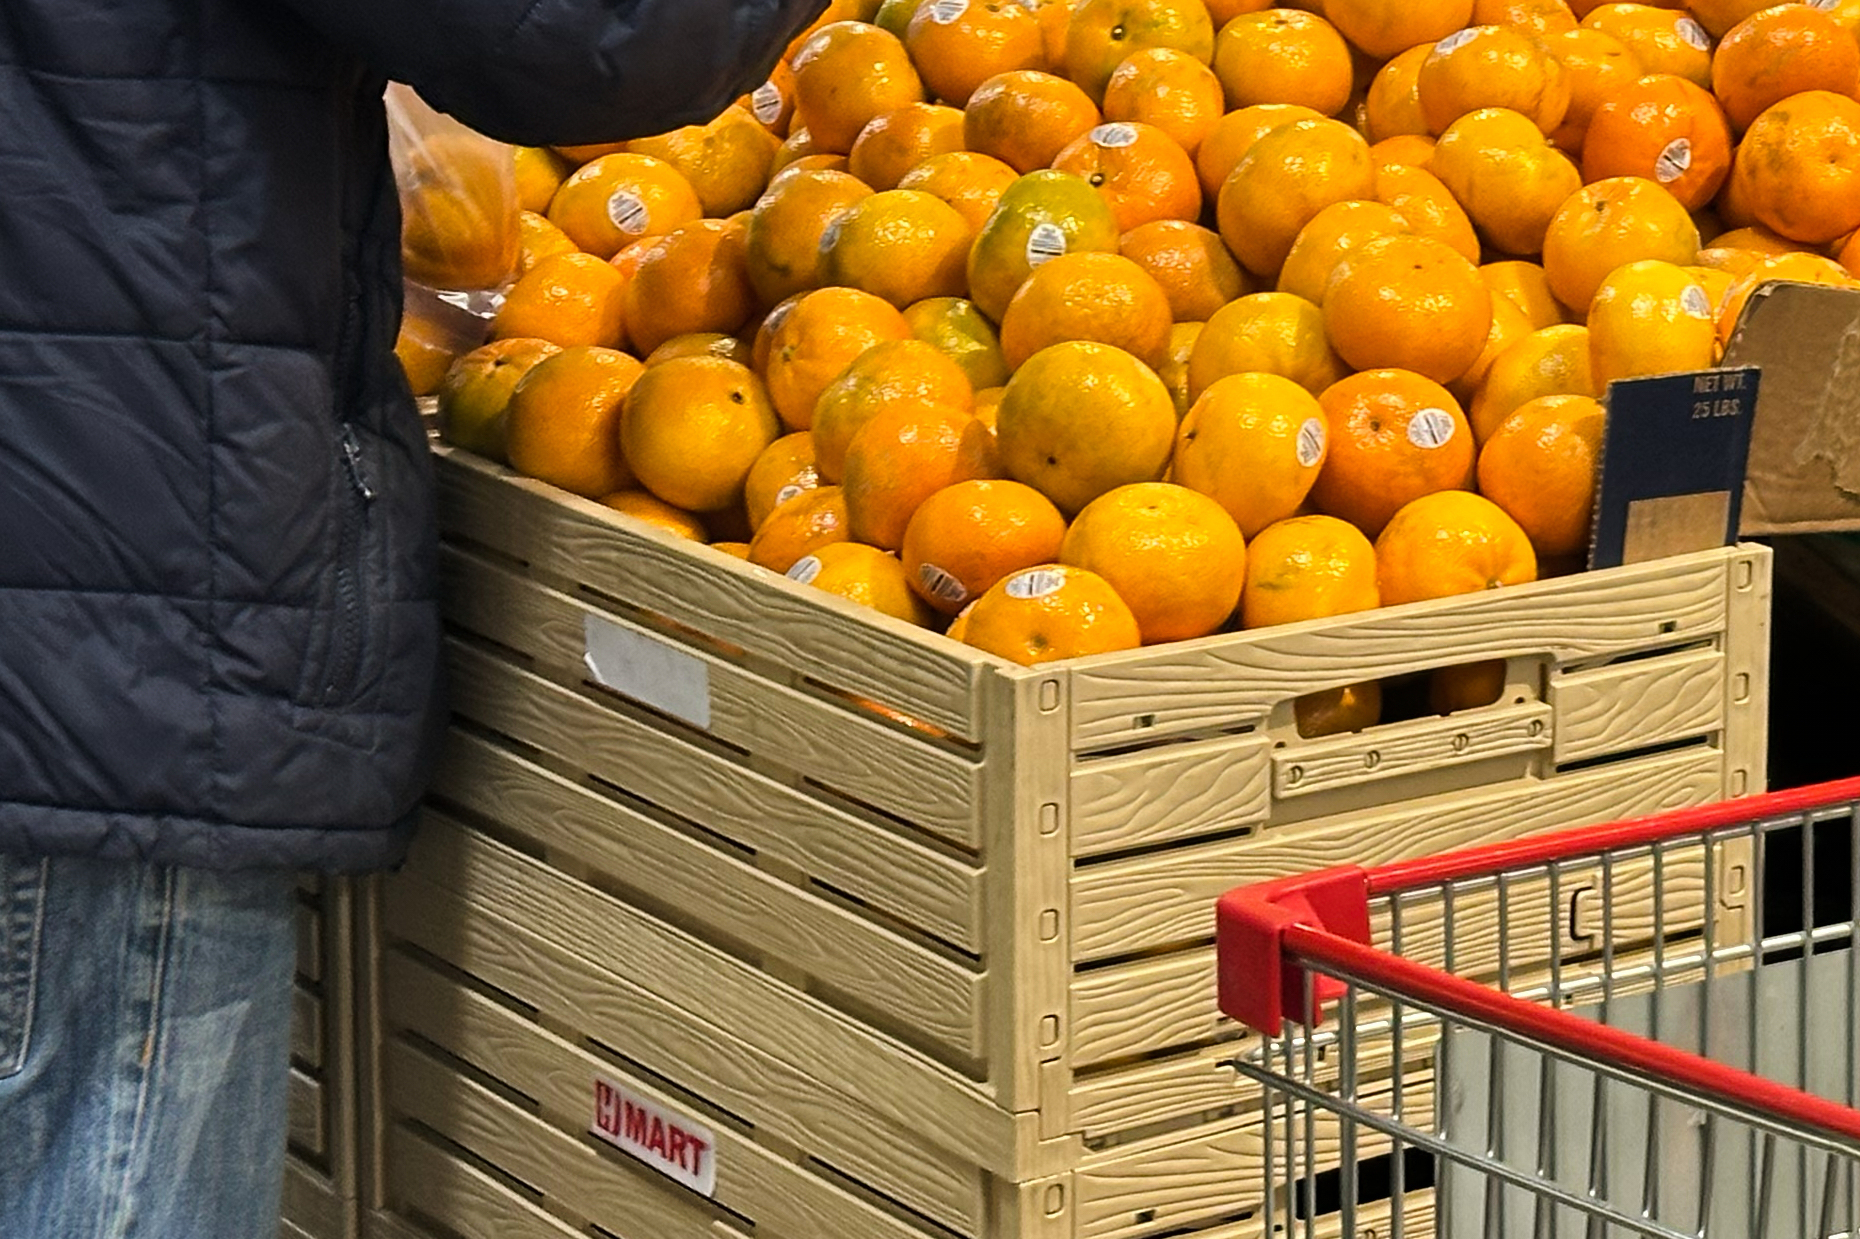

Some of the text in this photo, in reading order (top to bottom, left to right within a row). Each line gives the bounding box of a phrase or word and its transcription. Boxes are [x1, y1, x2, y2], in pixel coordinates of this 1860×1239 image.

[1694, 375, 1720, 393] NET
[1692, 401, 1711, 419] 25
[624, 1101, 709, 1176] MART
